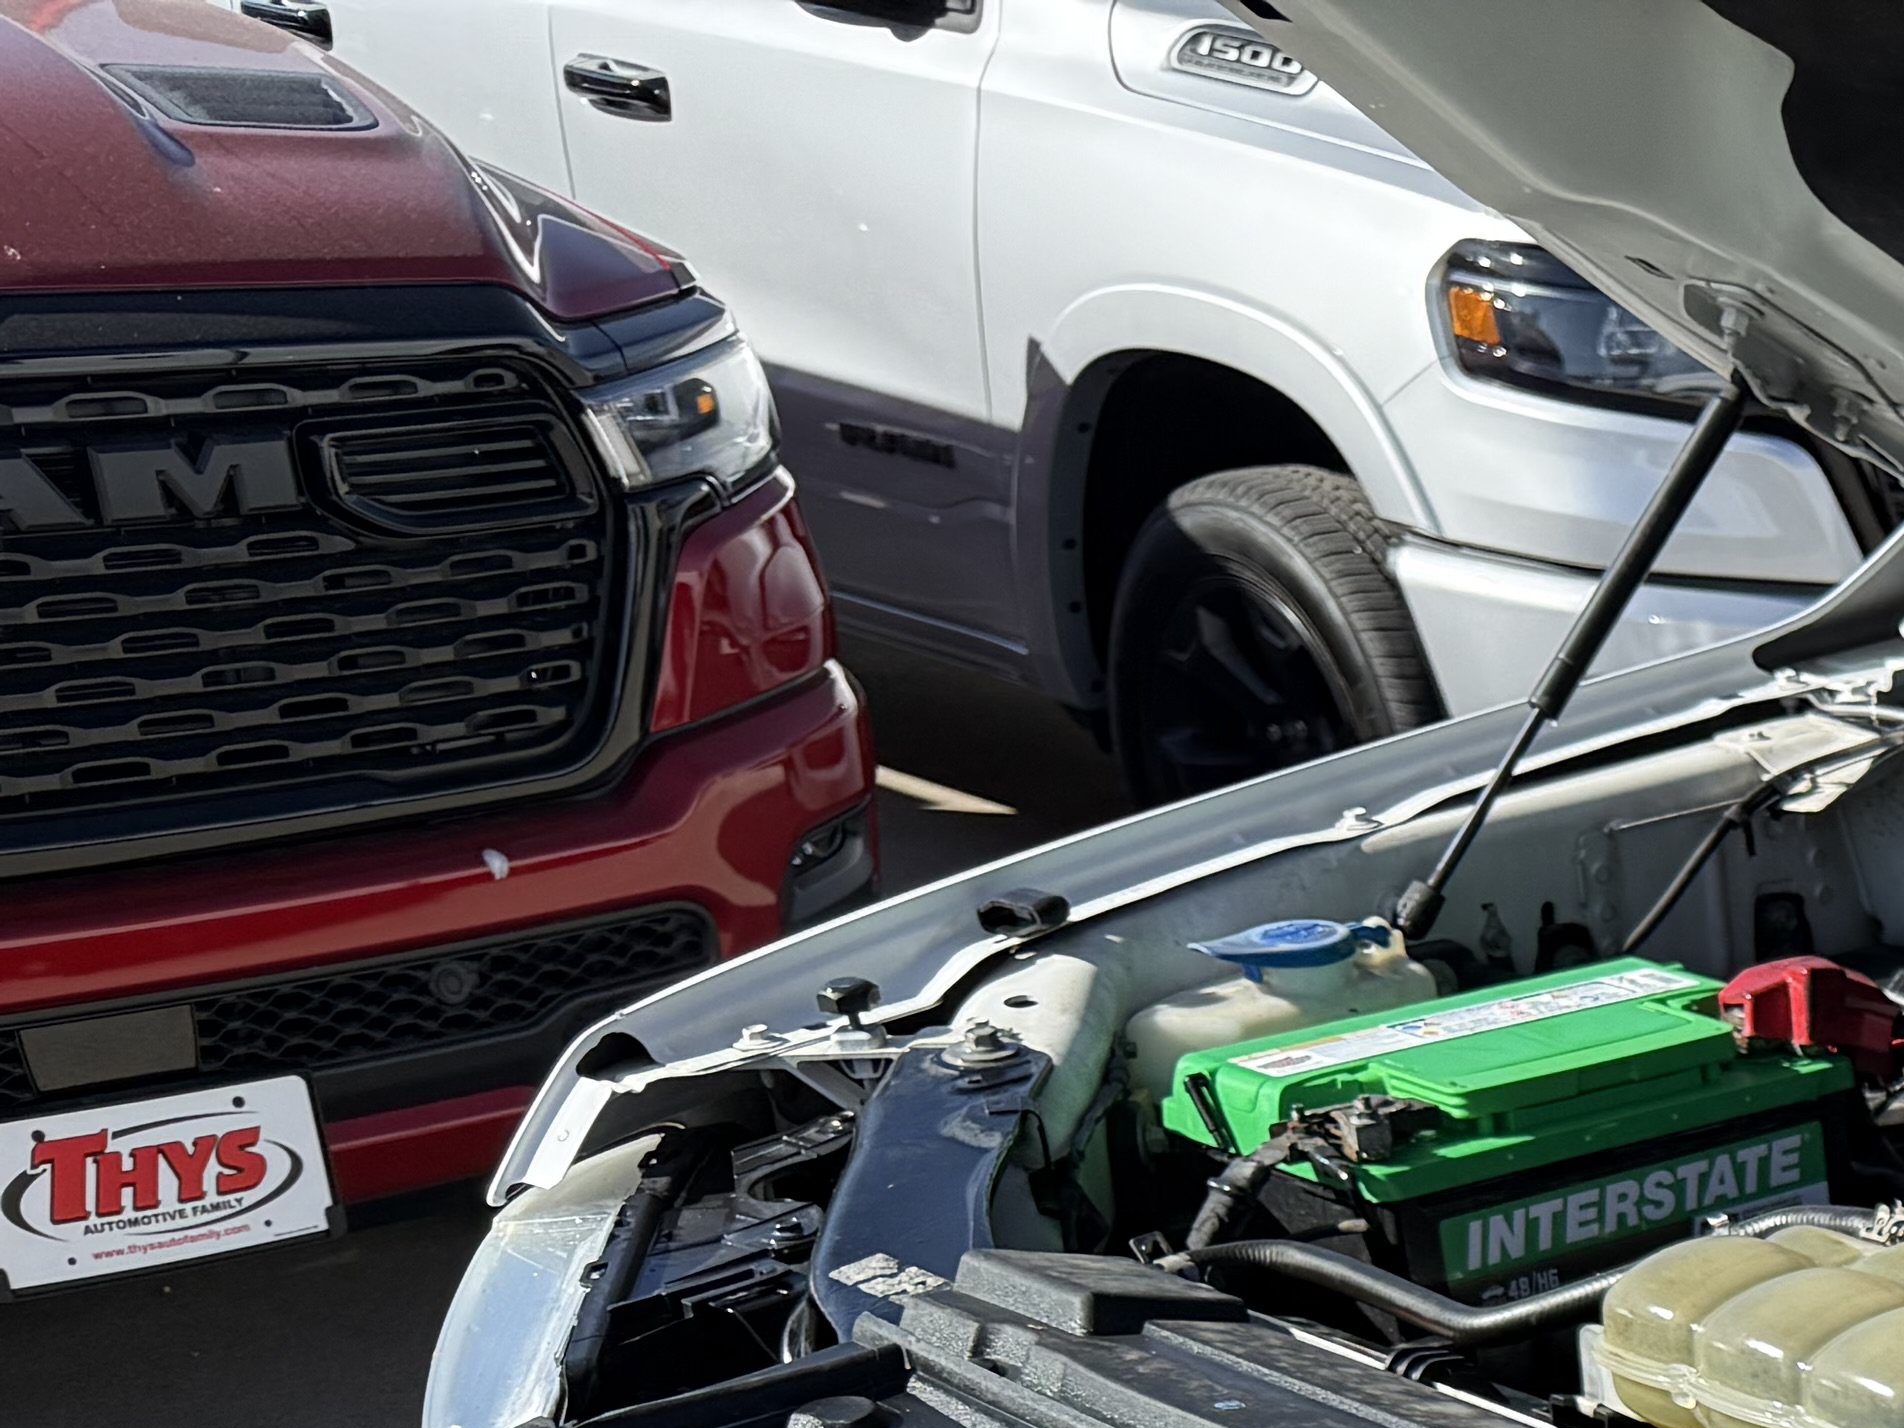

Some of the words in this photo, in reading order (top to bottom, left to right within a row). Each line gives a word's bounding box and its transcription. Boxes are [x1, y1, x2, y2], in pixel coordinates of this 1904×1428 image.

[1196, 32, 1303, 75] 1500
[31, 1125, 268, 1225] THYS
[83, 1208, 188, 1236] AUTOMOTIVE
[191, 1196, 245, 1217] FAMILY
[1467, 1134, 1802, 1271] INTERSTATE
[92, 1223, 251, 1261] www.thysautofamily.com
